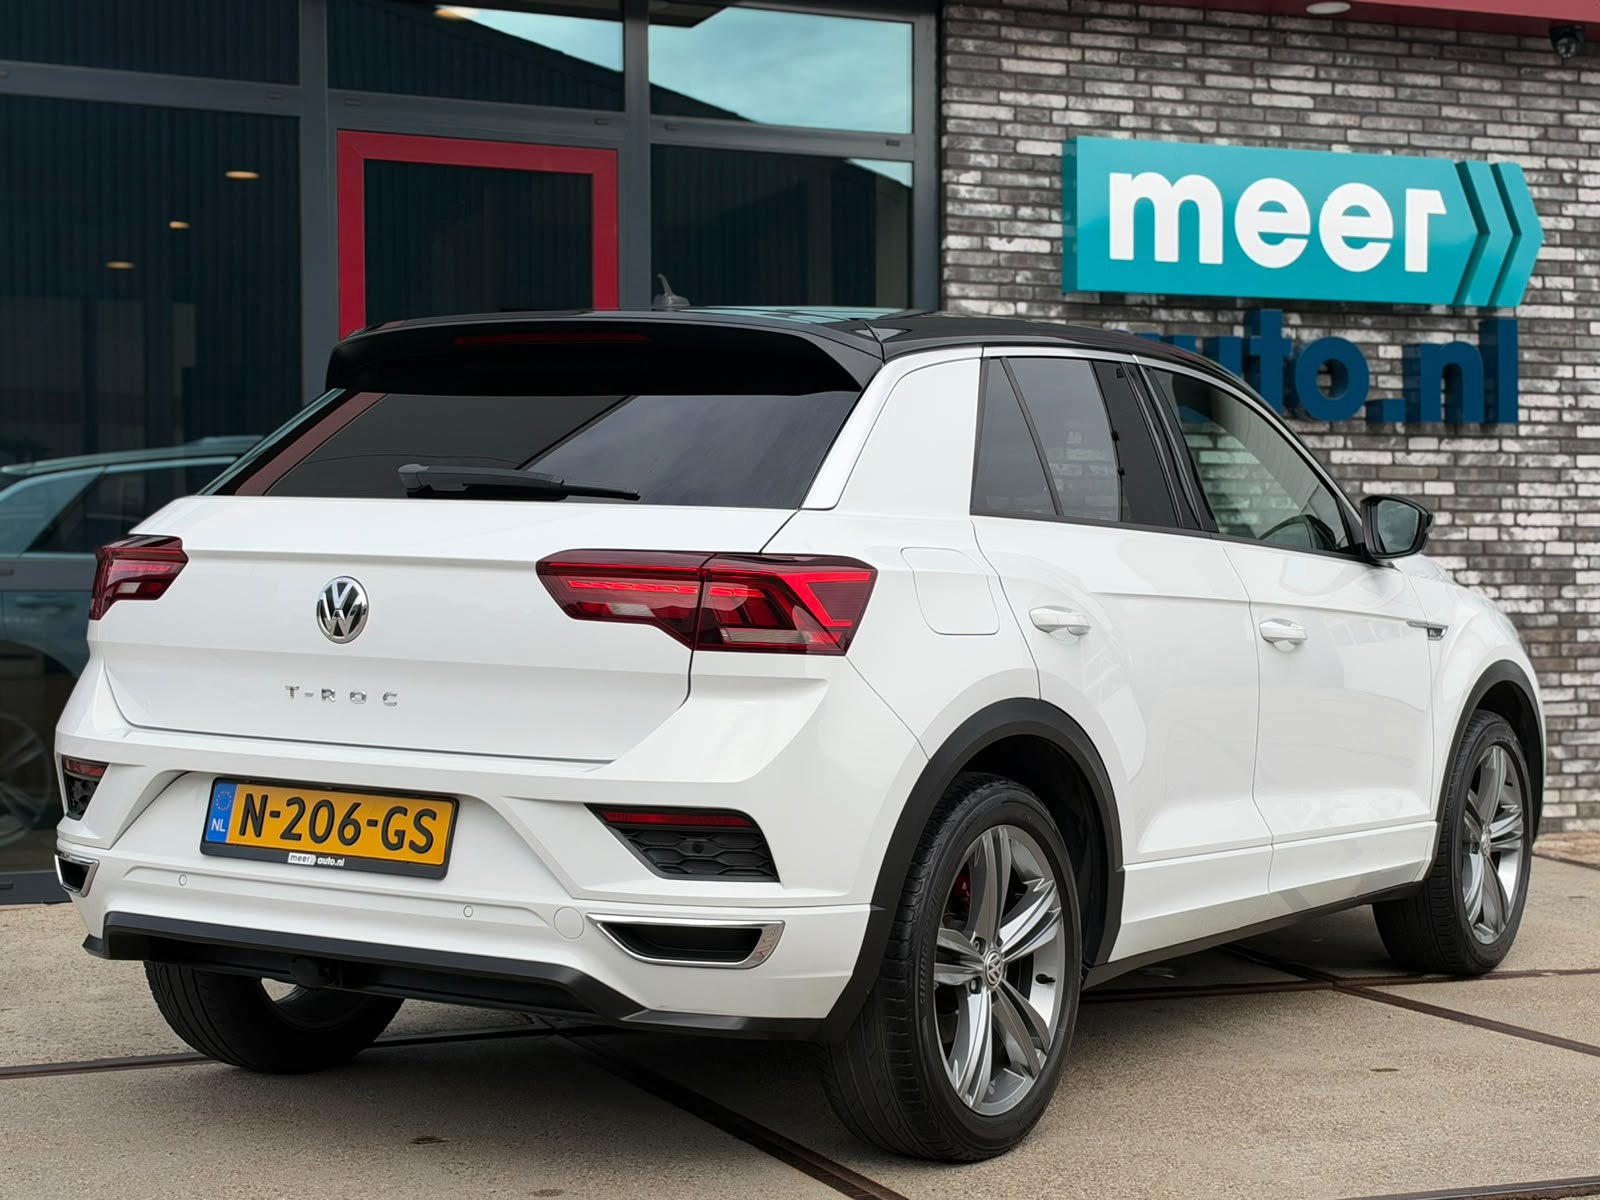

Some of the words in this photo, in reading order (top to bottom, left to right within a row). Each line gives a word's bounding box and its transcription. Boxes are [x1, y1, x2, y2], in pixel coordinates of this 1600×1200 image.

[1109, 171, 1447, 273] meer
[1110, 308, 1518, 424] to.nl
[285, 685, 398, 706] T-ROC
[210, 817, 226, 833] NL
[238, 793, 438, 854] N-206-GS
[290, 854, 312, 864] meer
[317, 856, 345, 867] auto.nl
